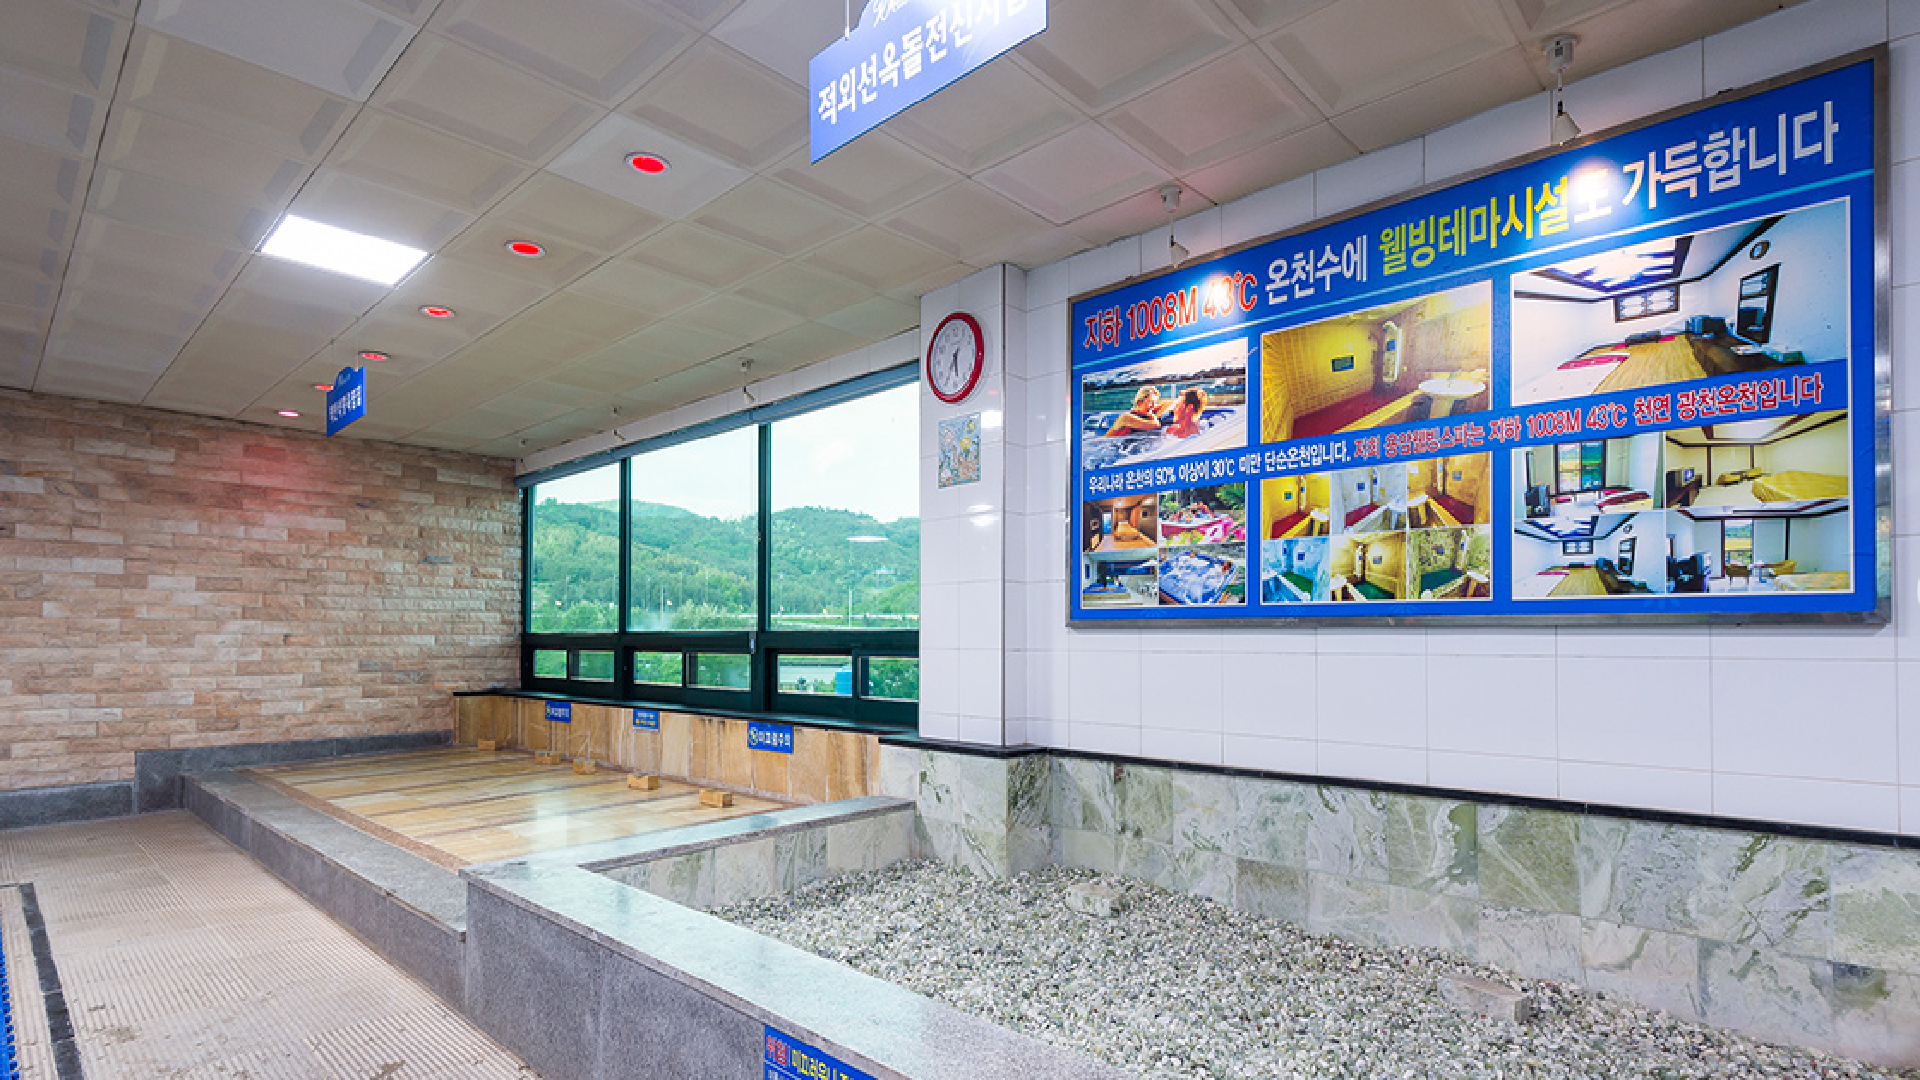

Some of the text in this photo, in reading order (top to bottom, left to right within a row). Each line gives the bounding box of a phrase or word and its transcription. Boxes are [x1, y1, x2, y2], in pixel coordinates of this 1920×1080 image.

[1084, 305, 1122, 351] 지하
[1126, 286, 1199, 340] 1008M
[1265, 234, 1370, 306] 온천수에
[1621, 101, 1840, 210] 가득합니다
[1089, 472, 1124, 494] 우리나라
[1154, 465, 1176, 484] 90%
[1178, 457, 1210, 482] 이상이
[1238, 452, 1261, 475] 미만
[1264, 440, 1352, 472] 단순온천입니다.
[1353, 434, 1381, 461] 저희
[1383, 421, 1486, 458] 용암웰빙스파는
[1489, 413, 1521, 443] 지하
[1525, 407, 1582, 439] 1008M
[1633, 392, 1672, 427] 천연
[1676, 371, 1825, 421] 광천온천입니다
